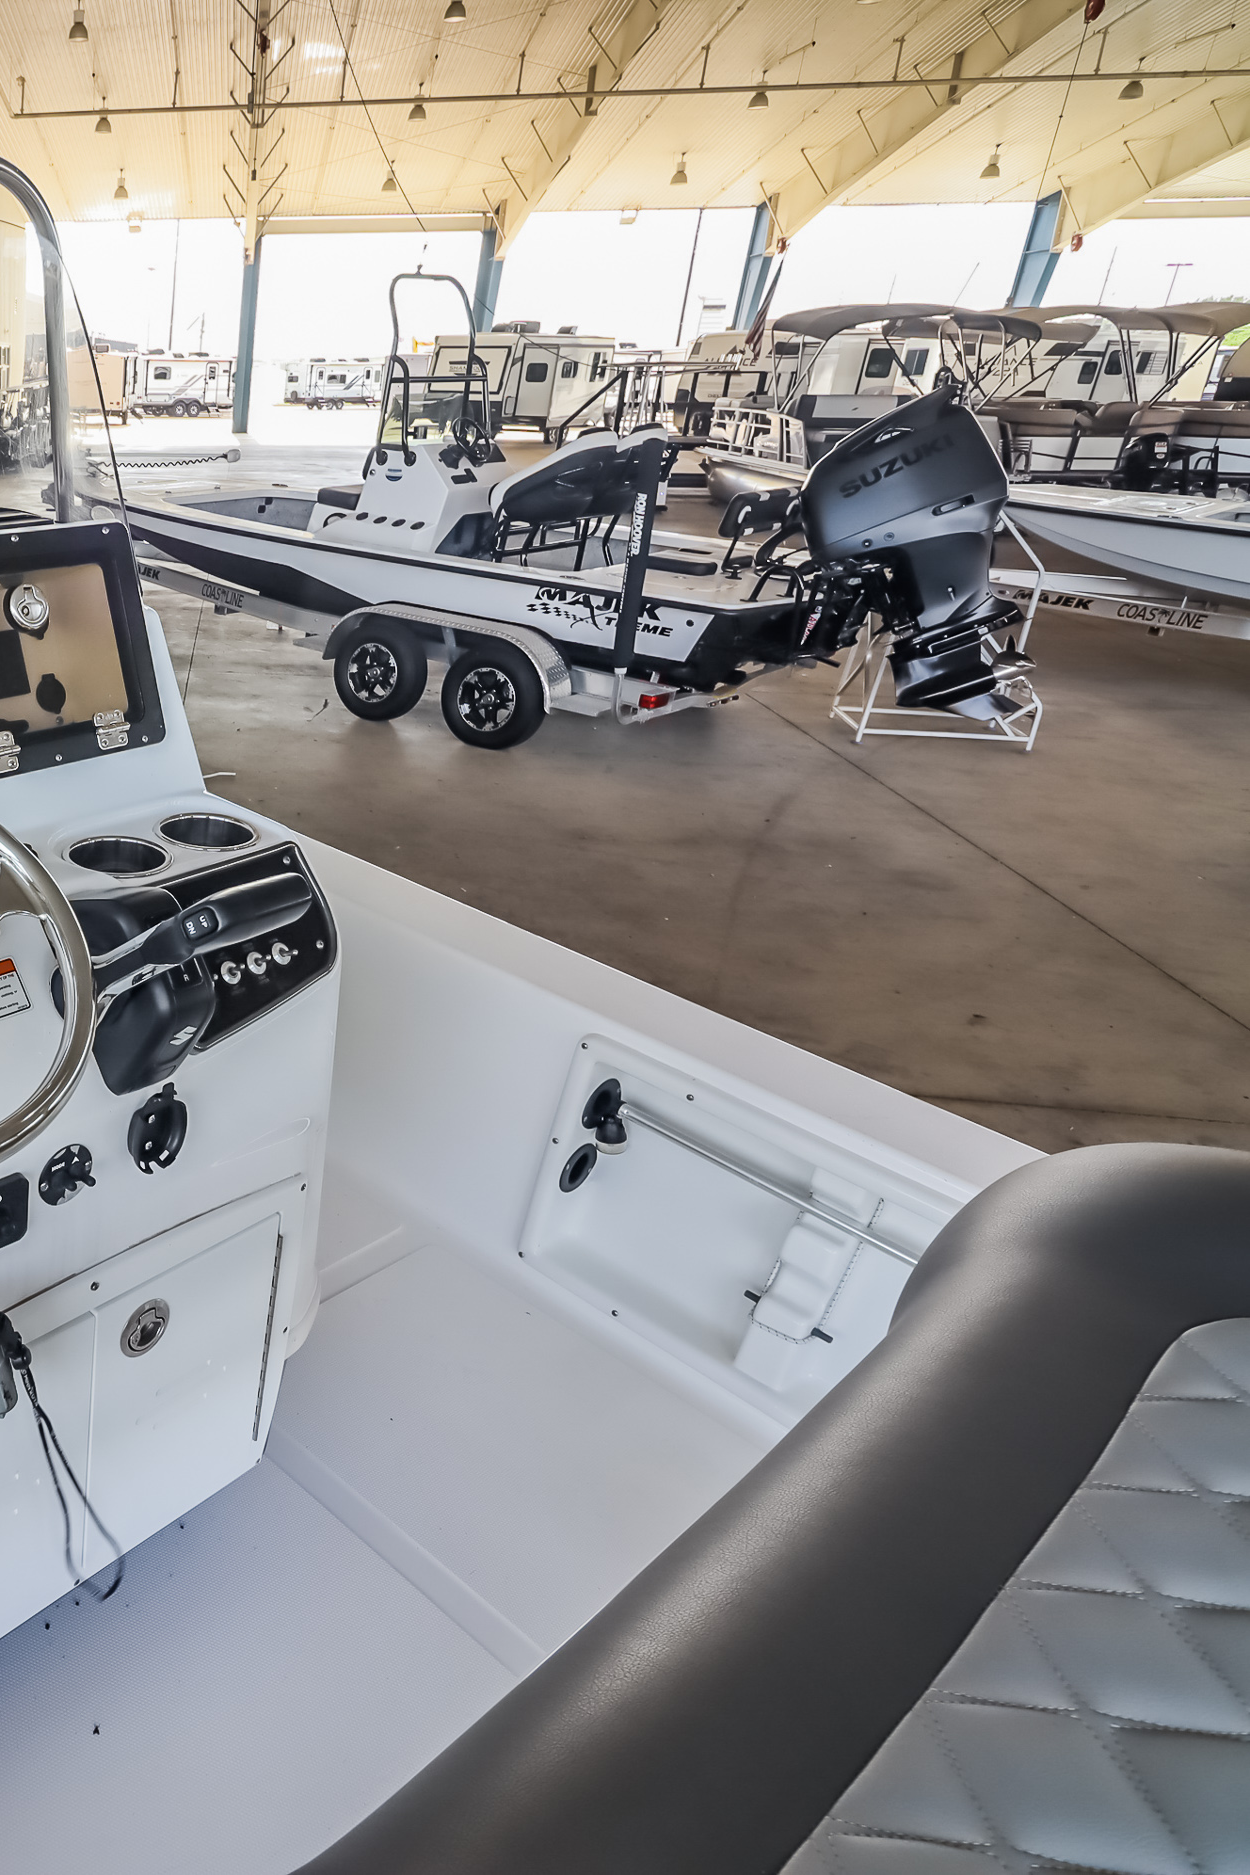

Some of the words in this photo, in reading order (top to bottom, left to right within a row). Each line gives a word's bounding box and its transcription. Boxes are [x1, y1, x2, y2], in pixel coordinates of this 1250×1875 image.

[839, 434, 955, 498] SUZUKI
[635, 492, 647, 514] RON
[630, 514, 644, 557] HOOVER
[138, 564, 160, 580] JEK
[535, 586, 661, 622] MAJK
[185, 921, 197, 935] DN
[199, 915, 208, 928] UP
[51, 1161, 66, 1173] MODE
